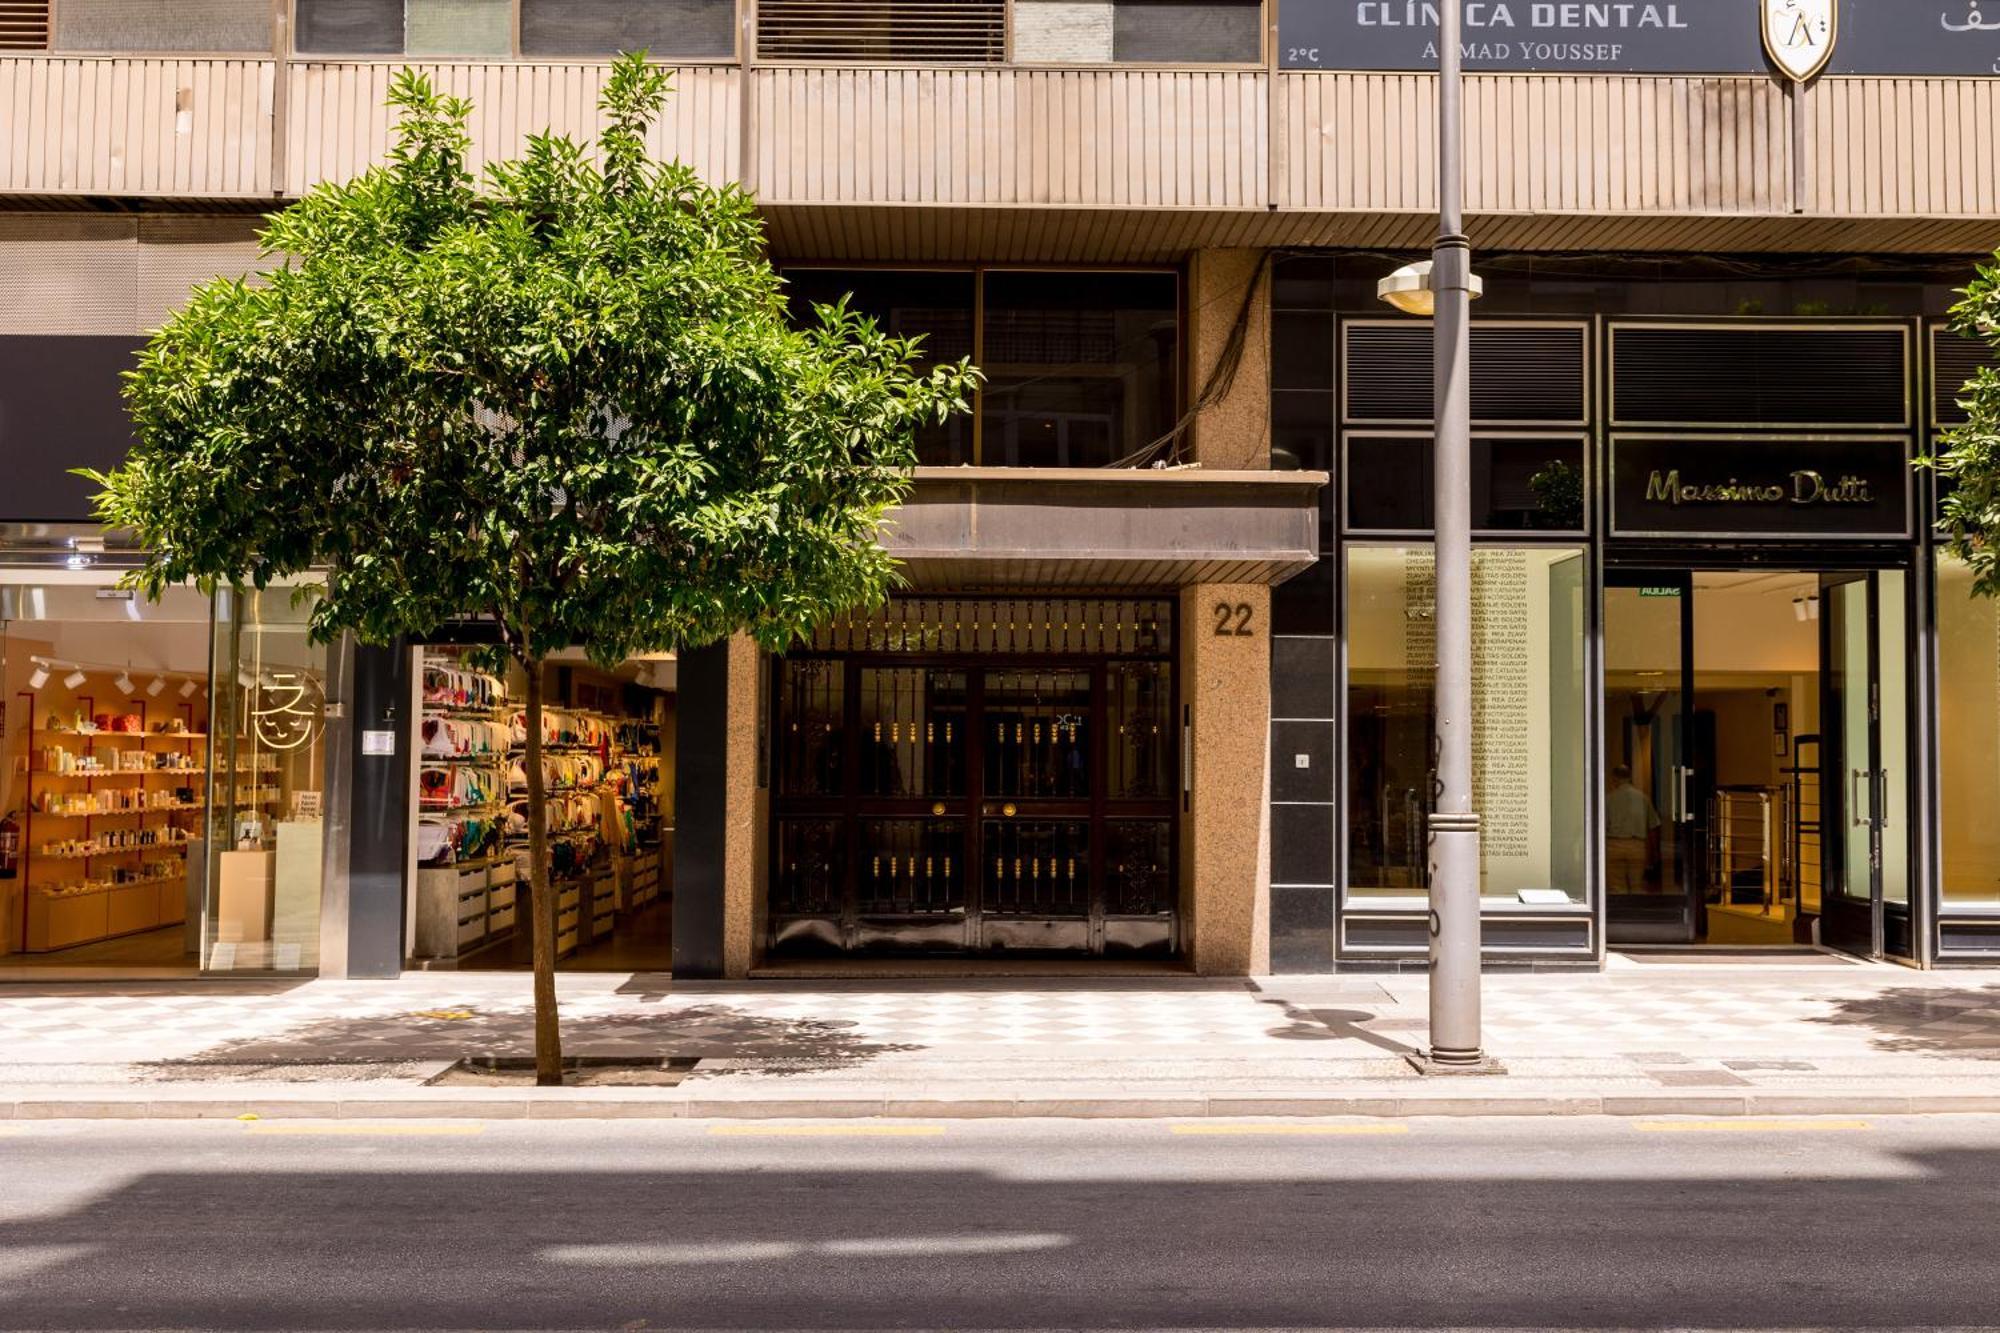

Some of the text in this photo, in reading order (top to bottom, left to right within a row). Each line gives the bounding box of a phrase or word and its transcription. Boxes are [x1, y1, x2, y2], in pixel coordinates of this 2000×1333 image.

[1357, 0, 1688, 28] CLÍNCA DENTAL
[1422, 41, 1623, 61] AMAD YOUSSEF
[1646, 469, 1876, 505] Massimo Dutti
[1215, 603, 1253, 636] 22
